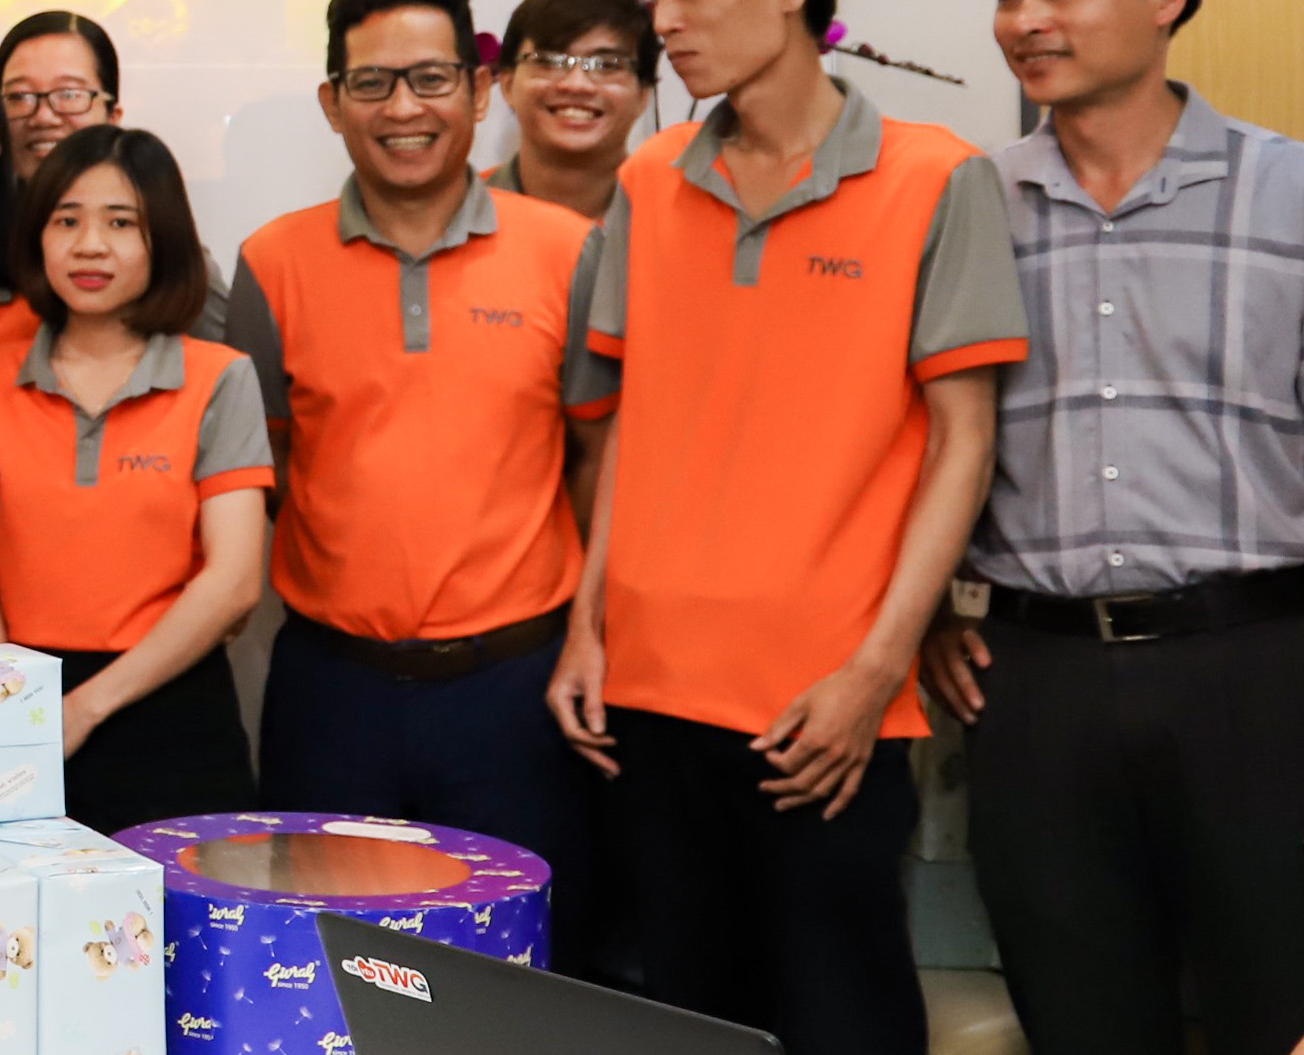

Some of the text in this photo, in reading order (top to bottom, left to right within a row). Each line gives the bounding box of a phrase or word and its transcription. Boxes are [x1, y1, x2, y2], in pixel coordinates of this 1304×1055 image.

[806, 255, 864, 278] TWG
[469, 307, 523, 328] TWG
[118, 454, 171, 473] TWG
[264, 962, 316, 987] Givral
[373, 961, 428, 994] TWG
[177, 1013, 212, 1035] Givra
